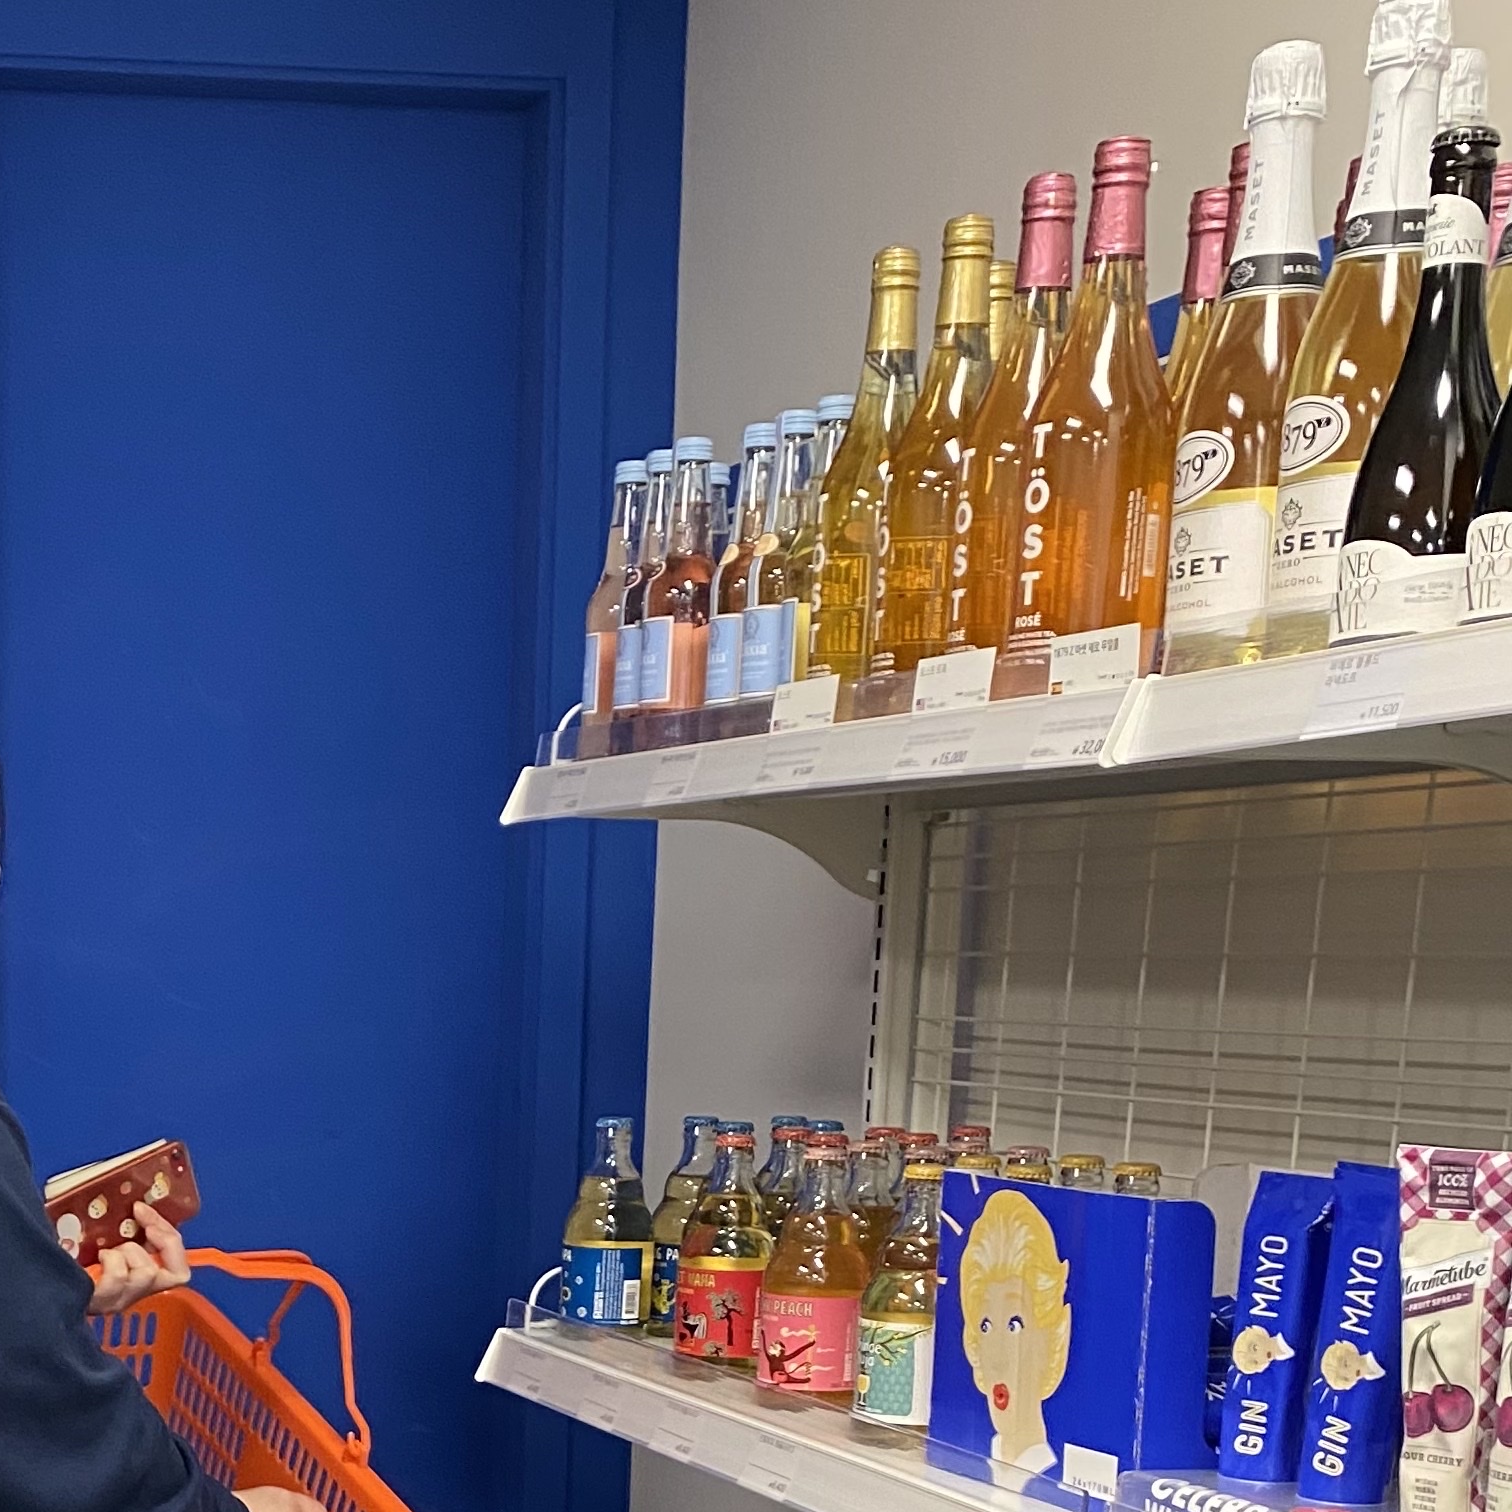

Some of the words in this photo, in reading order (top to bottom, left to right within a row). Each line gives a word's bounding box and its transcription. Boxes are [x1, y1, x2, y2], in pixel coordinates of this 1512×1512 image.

[1360, 110, 1386, 197] MASET
[1243, 159, 1264, 242] MASET
[1420, 239, 1486, 258] OLANT
[951, 447, 977, 622] TÖST
[1021, 422, 1053, 606] TÖST
[1273, 528, 1344, 557] ASET
[773, 1299, 813, 1317] PEACH
[1249, 1234, 1289, 1319] MAYO
[1339, 1245, 1384, 1336] MAYO
[1232, 1398, 1269, 1457] GIN
[1311, 1414, 1352, 1479] GIN
[1402, 1450, 1425, 1462] OUR
